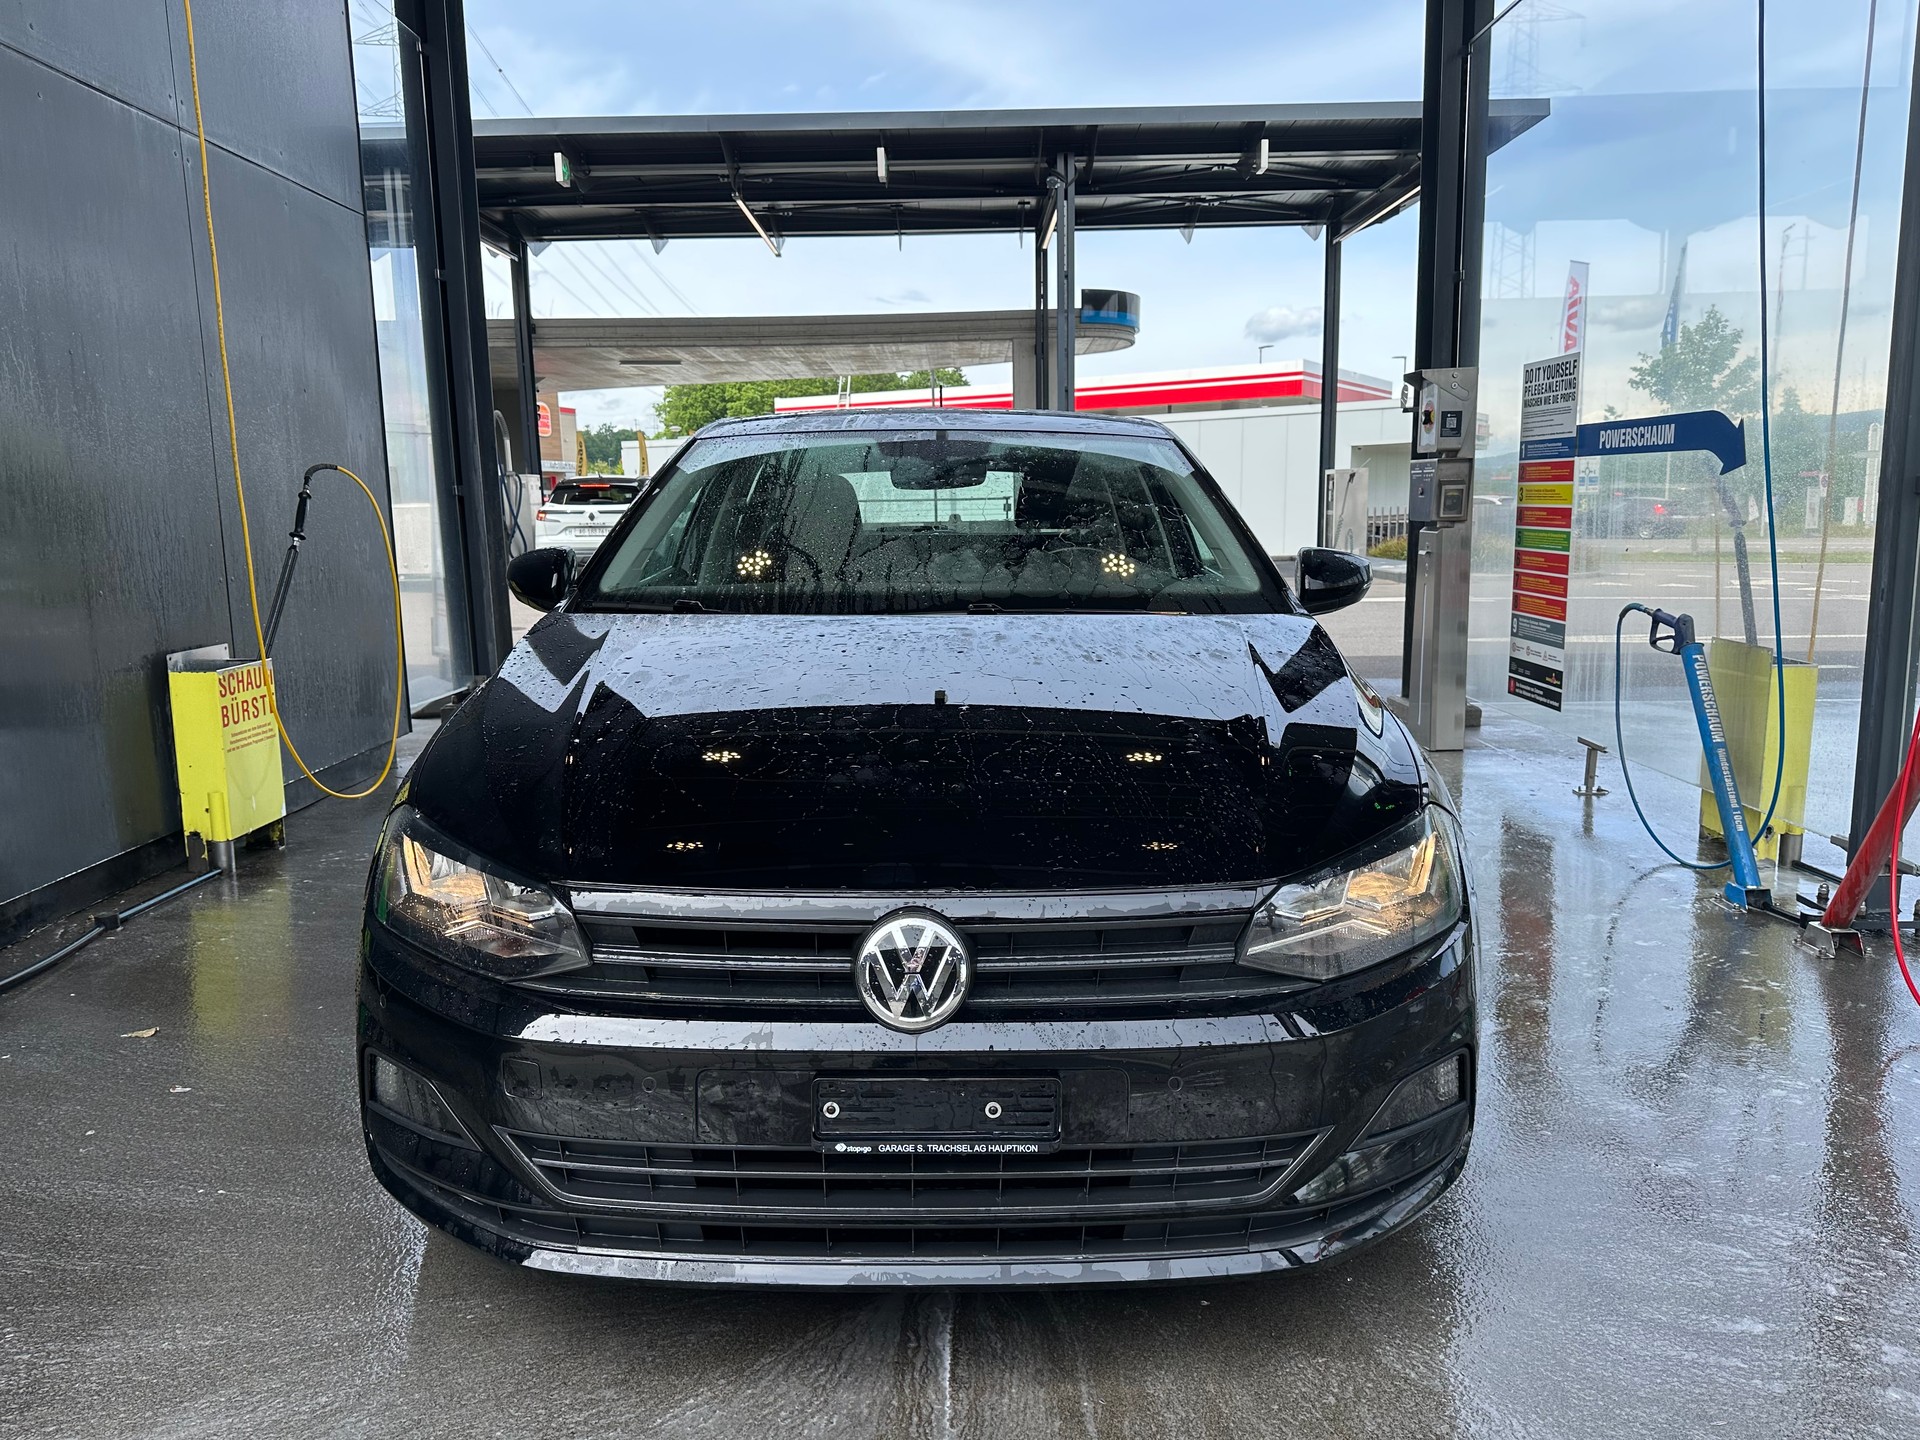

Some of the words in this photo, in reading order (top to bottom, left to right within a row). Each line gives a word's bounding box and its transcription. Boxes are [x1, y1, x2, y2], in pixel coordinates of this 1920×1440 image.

[1525, 368, 1534, 384] DO
[1535, 366, 1542, 382] IT
[1542, 359, 1578, 381] YOURSELF
[1524, 377, 1577, 397] PFLEGEANLEITUNG
[1524, 397, 1543, 408] WASCHEN
[1543, 395, 1552, 405] WIE
[1560, 391, 1577, 403] PROFIS
[1599, 423, 1675, 449] POWERSCHAUM
[1521, 443, 1526, 458] 1
[1519, 487, 1524, 502] 3
[1512, 618, 1518, 632] 9
[1692, 654, 1725, 743] POWERSCHAUM
[1717, 748, 1739, 809] Mindestabstand
[858, 917, 968, 1025] VW
[878, 1144, 915, 1153] GARAGE
[917, 1144, 926, 1153] S.
[927, 1144, 972, 1153] TRACHSEL
[974, 1144, 987, 1153] AG
[988, 1144, 1038, 1153] HAUPTIKON
